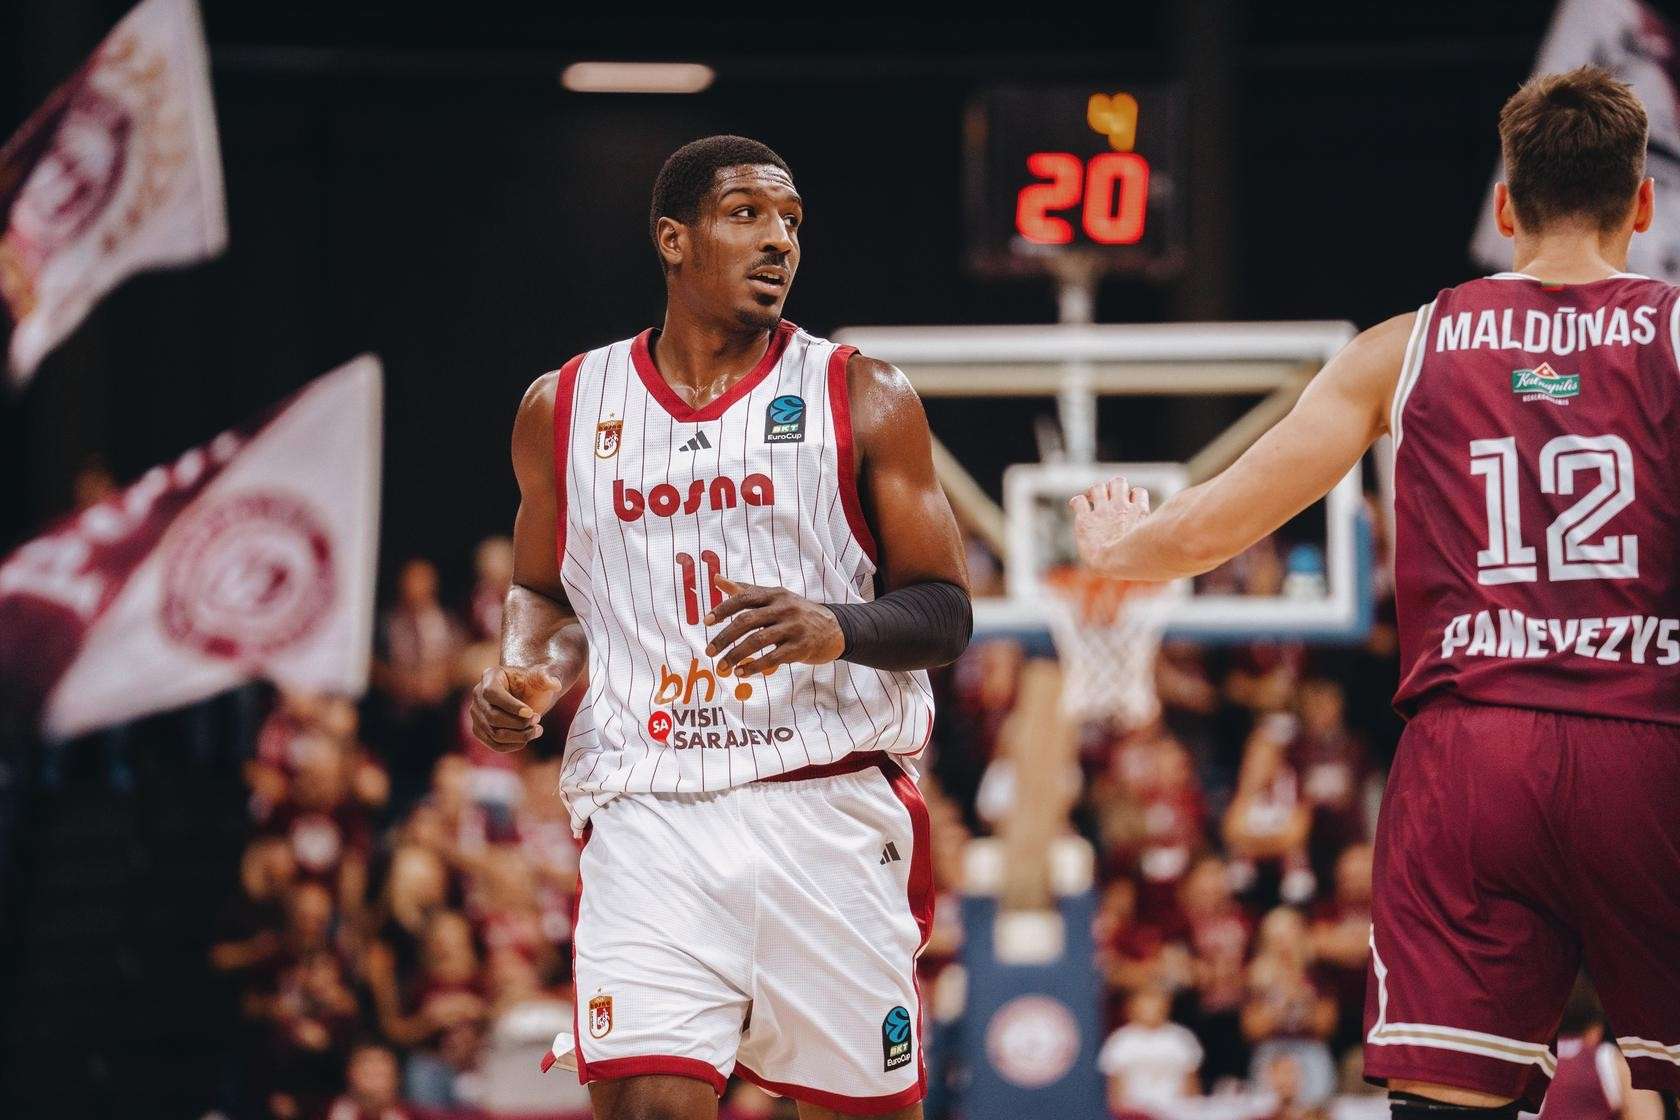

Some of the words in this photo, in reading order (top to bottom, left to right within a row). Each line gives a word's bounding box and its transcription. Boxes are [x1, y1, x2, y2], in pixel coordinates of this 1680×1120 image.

[1015, 152, 1149, 244] 20
[1436, 305, 1657, 356] MALDŪNAS
[767, 433, 802, 441] EuroCup
[613, 473, 775, 522] bosna
[1470, 434, 1639, 585] 12
[676, 550, 723, 625] 11
[653, 719, 669, 733] SA
[674, 726, 794, 749] SARAJEVO
[887, 1053, 910, 1066] EuroCup
